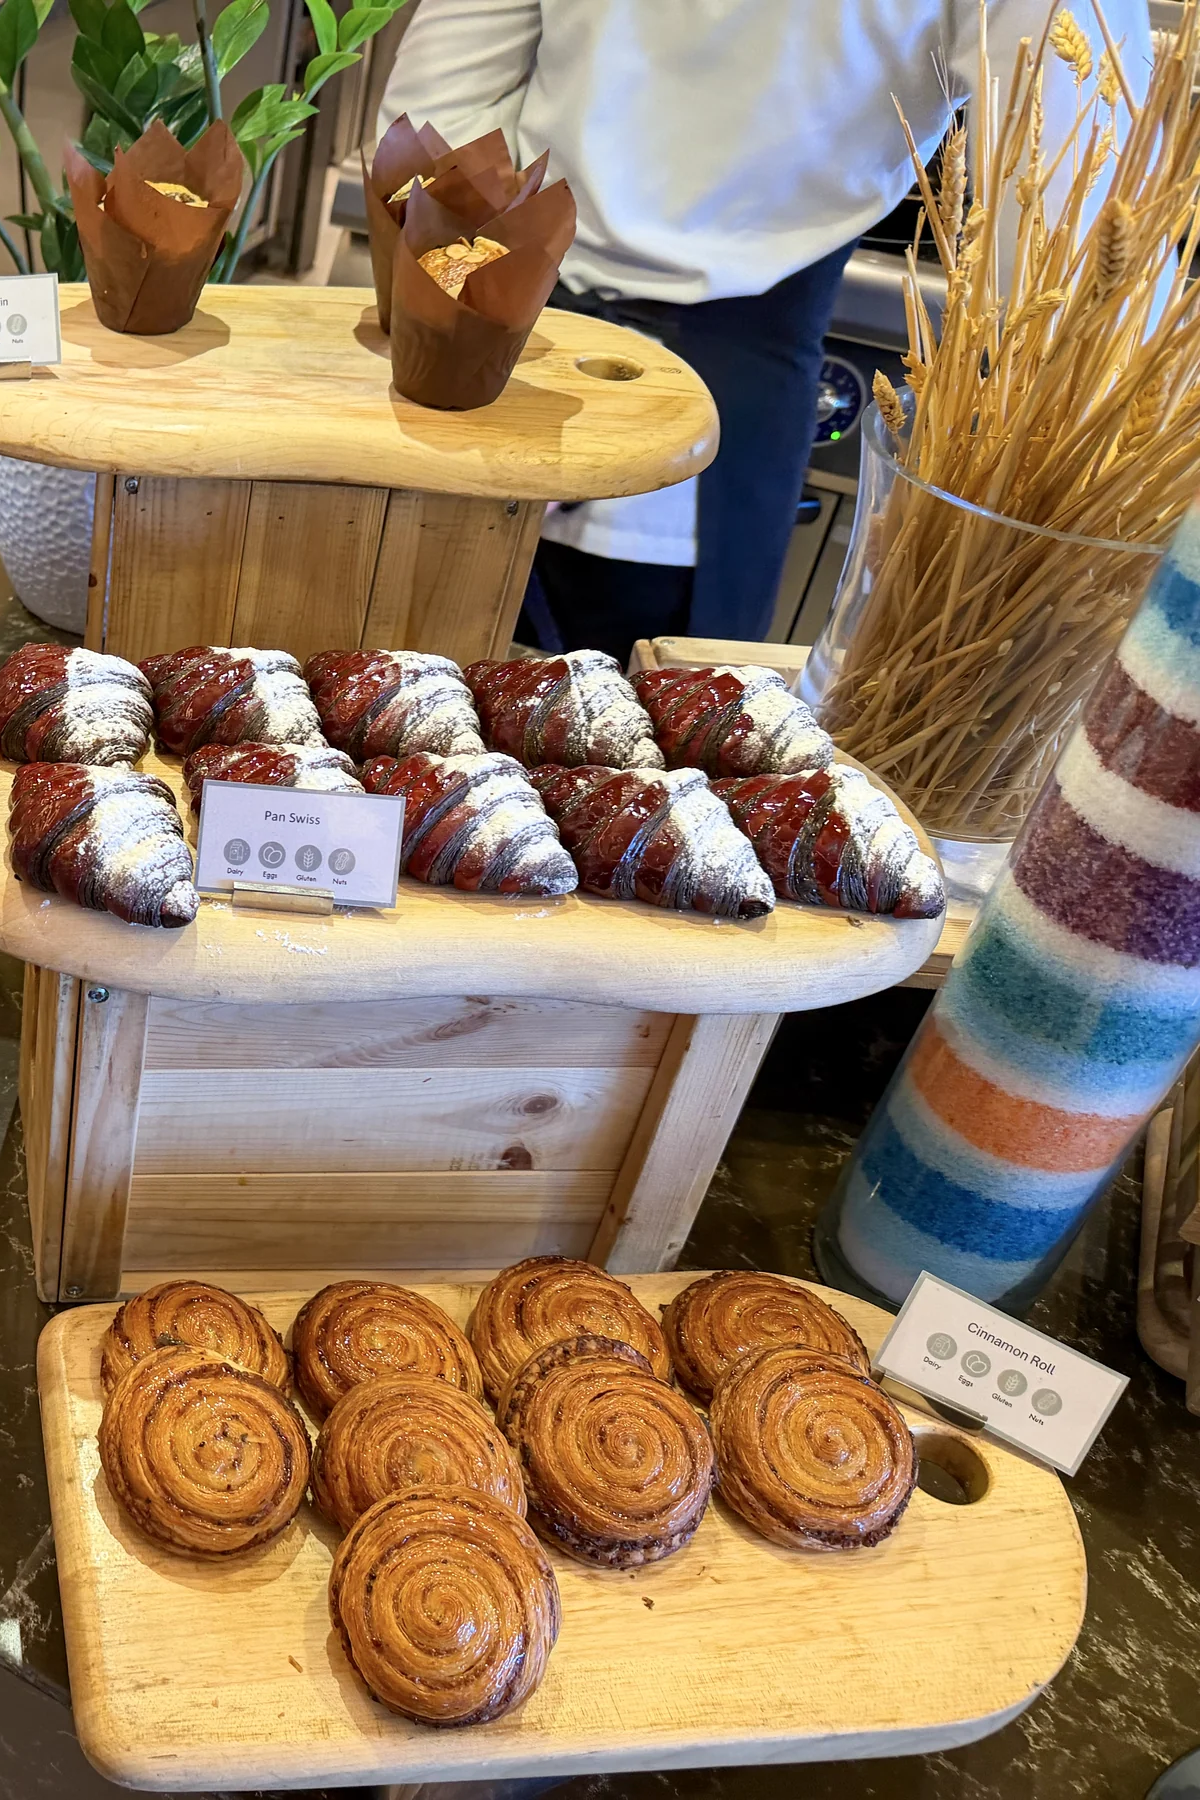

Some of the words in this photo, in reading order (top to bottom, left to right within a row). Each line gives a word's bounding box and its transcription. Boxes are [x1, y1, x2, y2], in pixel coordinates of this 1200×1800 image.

[264, 810, 286, 822] Pan
[288, 812, 321, 825] Swiss
[226, 867, 244, 876] Dairy
[262, 870, 278, 879] Eggs
[296, 874, 317, 882] Gluten
[967, 1322, 1029, 1362] Cinnamon
[1030, 1355, 1056, 1376] Roll
[922, 1356, 942, 1370] Dairy
[958, 1374, 974, 1388] Eggs
[991, 1392, 1013, 1408] Gluten
[1028, 1413, 1044, 1426] Nuts
